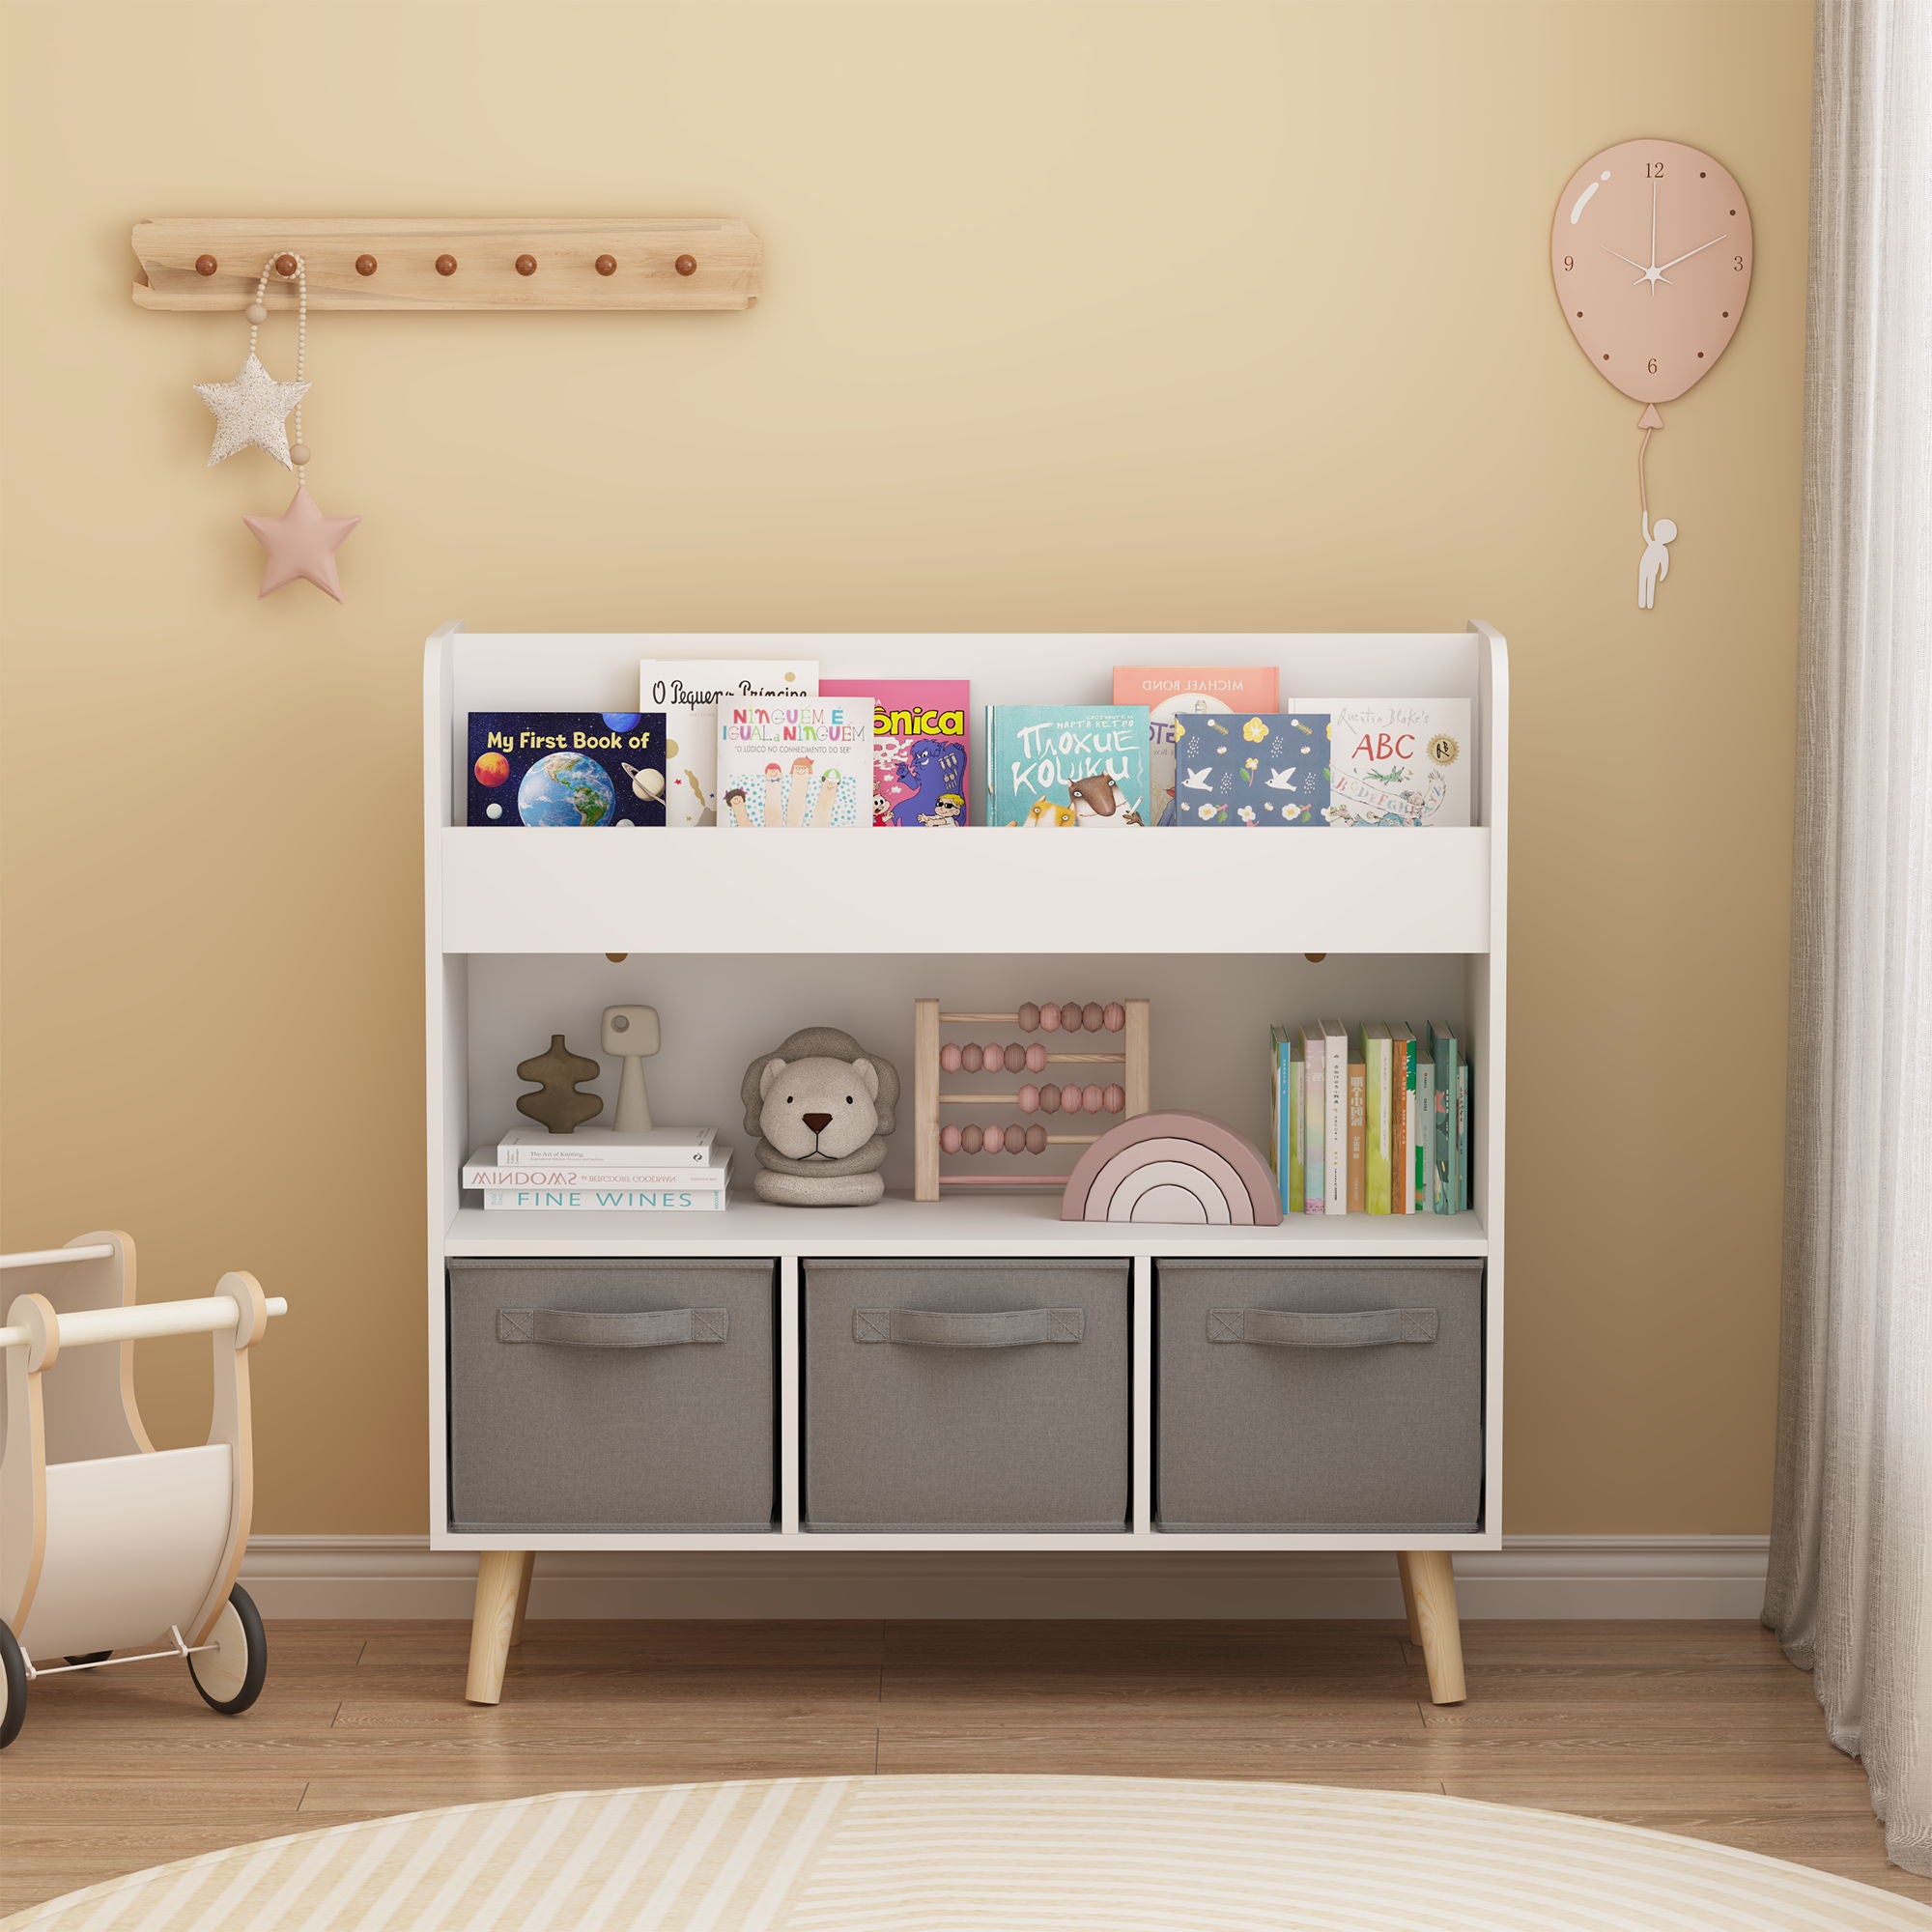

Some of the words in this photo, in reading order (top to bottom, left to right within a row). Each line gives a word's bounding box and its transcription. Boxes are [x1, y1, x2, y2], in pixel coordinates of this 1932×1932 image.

[1645, 162, 1664, 179] 12
[1564, 256, 1575, 271] 9
[1734, 256, 1744, 271] 3
[1647, 358, 1658, 374] 6
[653, 680, 666, 704] O
[874, 706, 964, 736] ônica
[487, 731, 514, 753] My
[520, 731, 568, 749] First
[573, 731, 623, 749] Book
[628, 732, 650, 749] of
[723, 725, 773, 741] IGUAL
[774, 732, 781, 742] a
[1351, 733, 1416, 761] ABC
[518, 1192, 582, 1207] FINE
[596, 1192, 692, 1208] WINES
